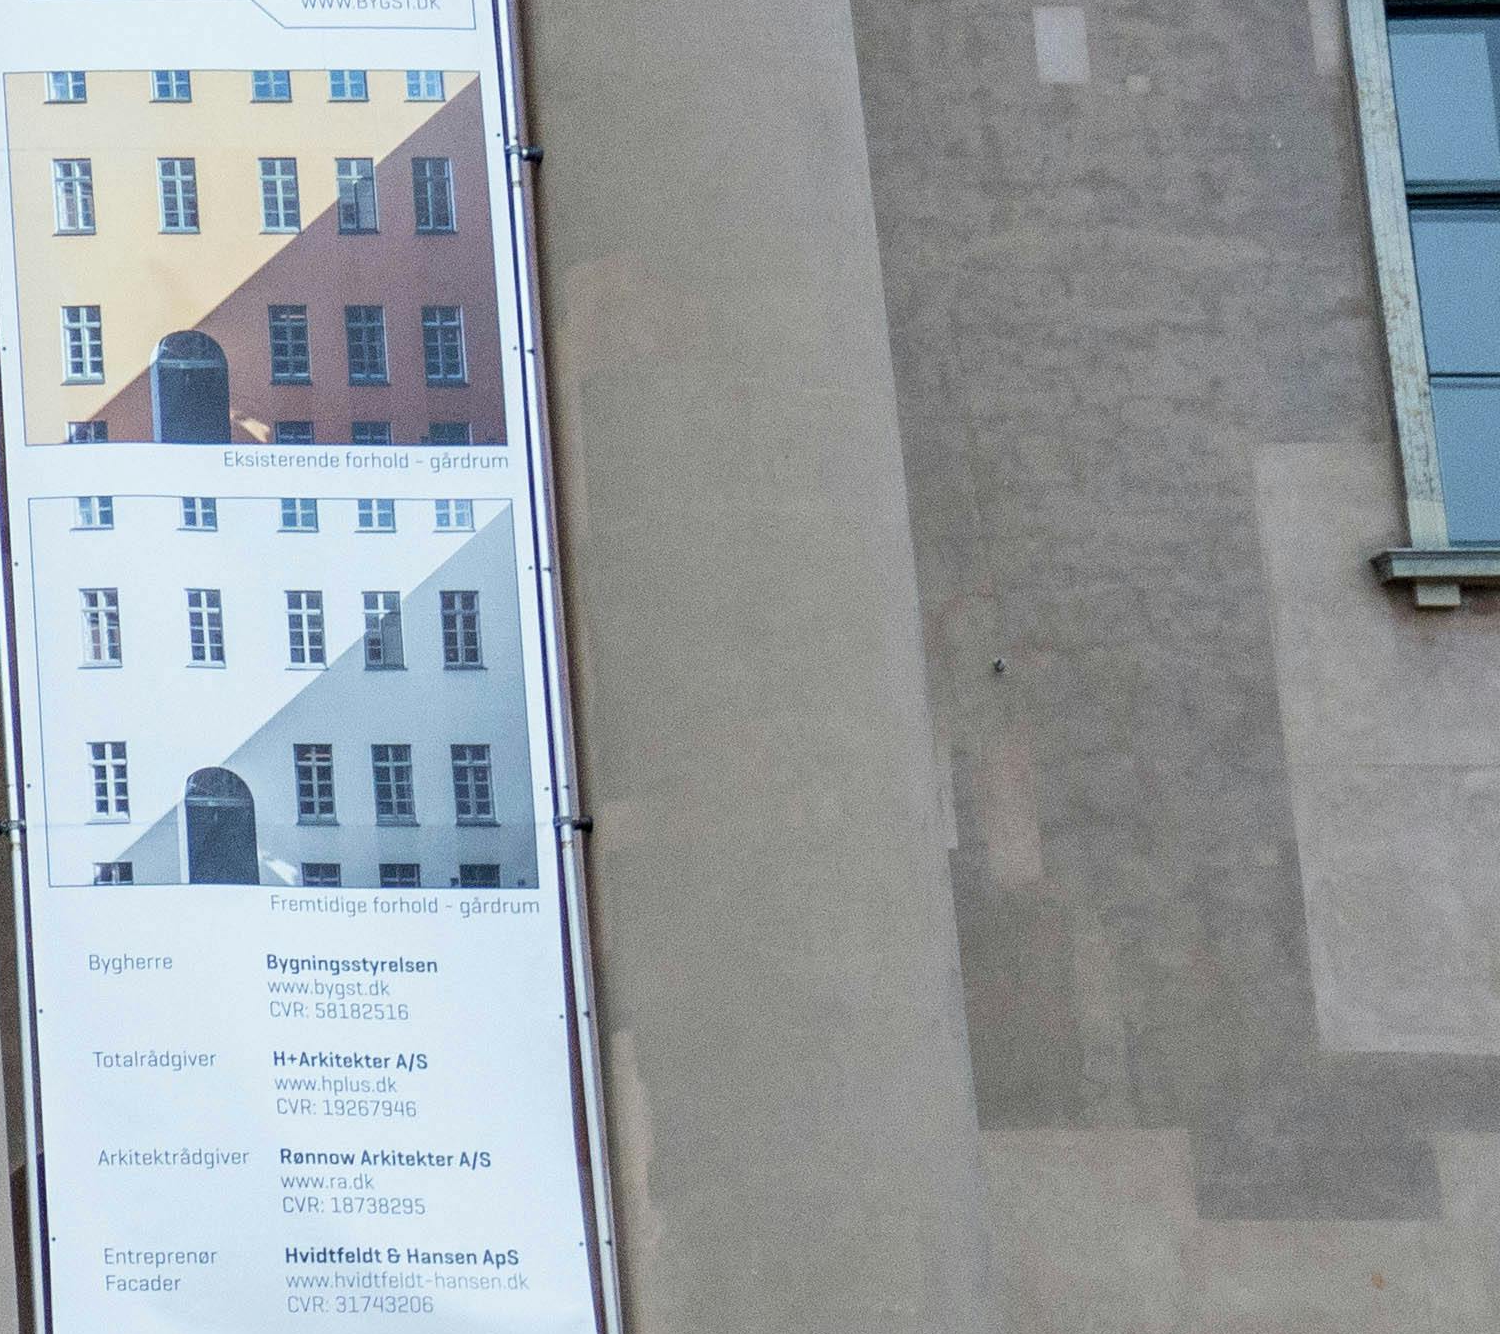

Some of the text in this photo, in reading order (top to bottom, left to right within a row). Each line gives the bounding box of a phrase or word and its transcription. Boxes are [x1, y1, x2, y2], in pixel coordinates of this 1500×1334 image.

[224, 451, 339, 468] Eksisterende
[346, 452, 409, 469] forhold
[430, 452, 508, 473] gårdrum
[271, 895, 367, 917] Fremtidige
[373, 897, 438, 914] forhold
[460, 897, 539, 918] gårdrum
[89, 954, 172, 974] Bygherre
[267, 954, 437, 976] Bygningsstyrelsen
[267, 979, 390, 1000] www.bygst.dk
[270, 1001, 408, 1020] CVR: 58182516
[93, 1050, 216, 1071] Totalrådgiver
[274, 1051, 428, 1072] H+Arkitekter A/S
[274, 1076, 397, 1096] www.hplus.dk
[277, 1098, 416, 1117] CVR: 19267946
[98, 1148, 249, 1169] Arkitektrådgiver
[280, 1148, 491, 1170] Rønnow Arkitekter A/S
[280, 1174, 374, 1190] www.ra.dk
[283, 1196, 425, 1215] CVR: 18738295
[104, 1248, 217, 1268] Entreprenør
[286, 1247, 519, 1269] Hvidtfeldt & Hansen ApS
[106, 1275, 181, 1291] Facader
[288, 1295, 433, 1313] CVR: 31743206
